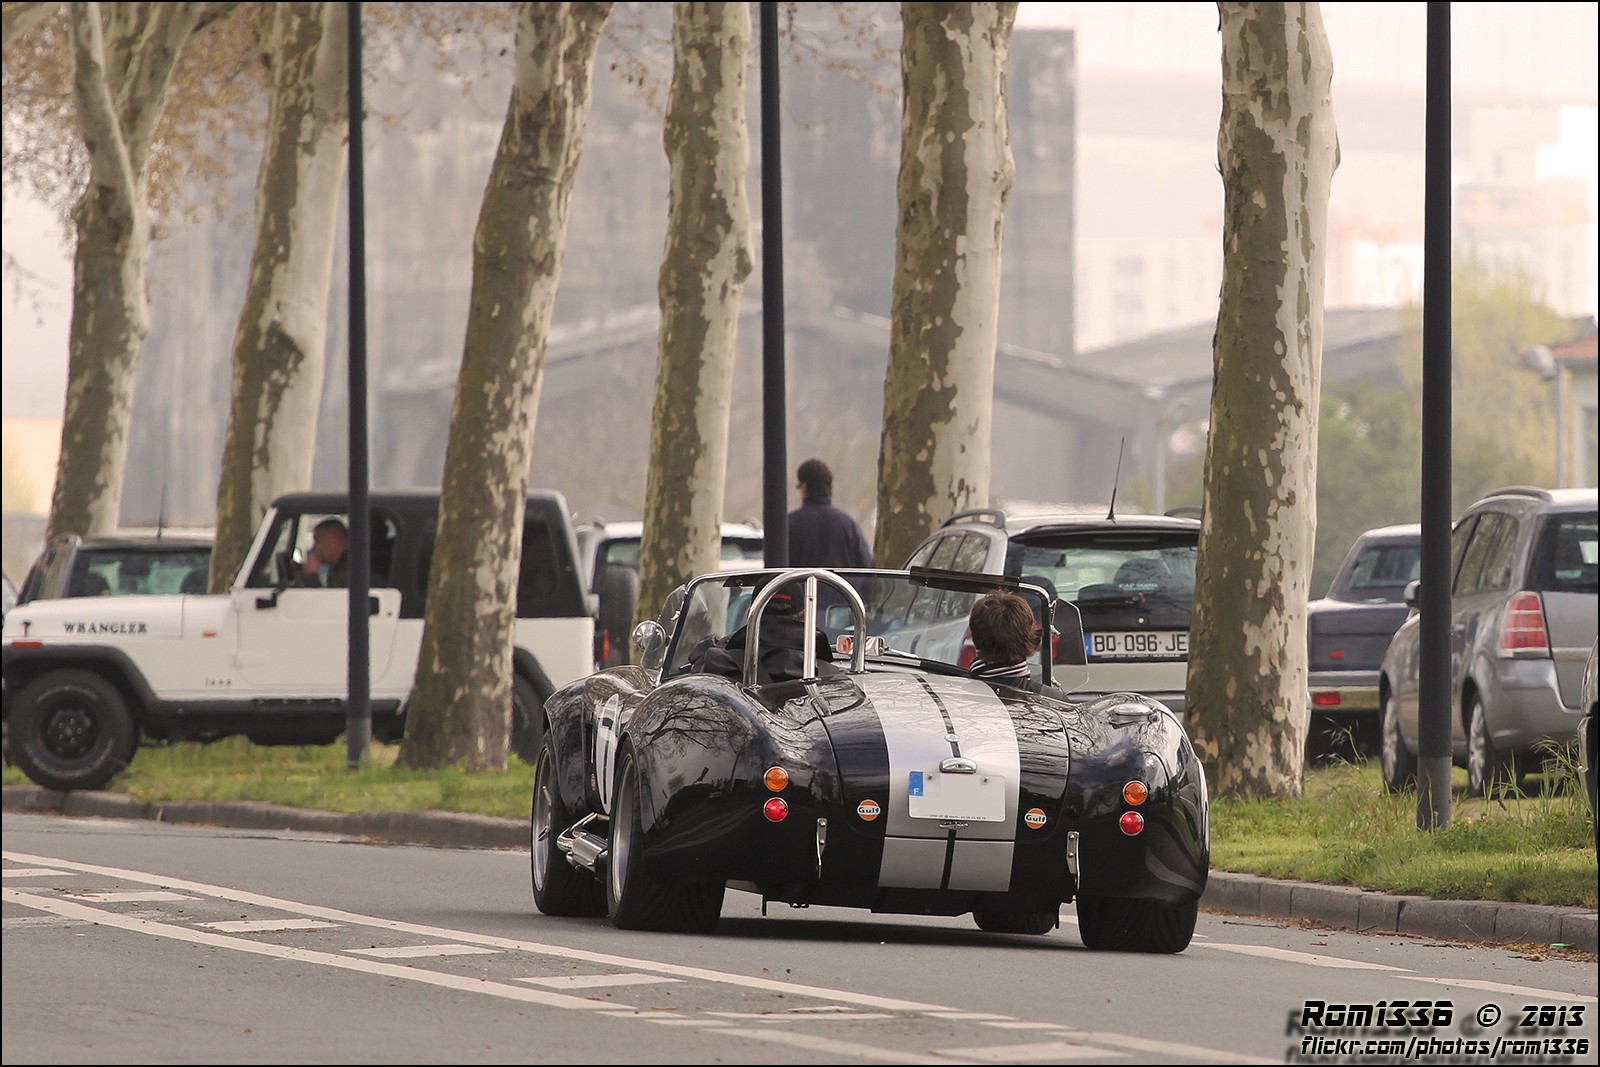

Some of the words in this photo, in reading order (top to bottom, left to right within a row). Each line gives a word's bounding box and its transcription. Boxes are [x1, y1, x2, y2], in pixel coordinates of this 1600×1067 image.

[63, 621, 148, 634] WRANGLER
[913, 787, 919, 795] F
[858, 806, 879, 814] Gulf
[1025, 813, 1046, 822] Gulf
